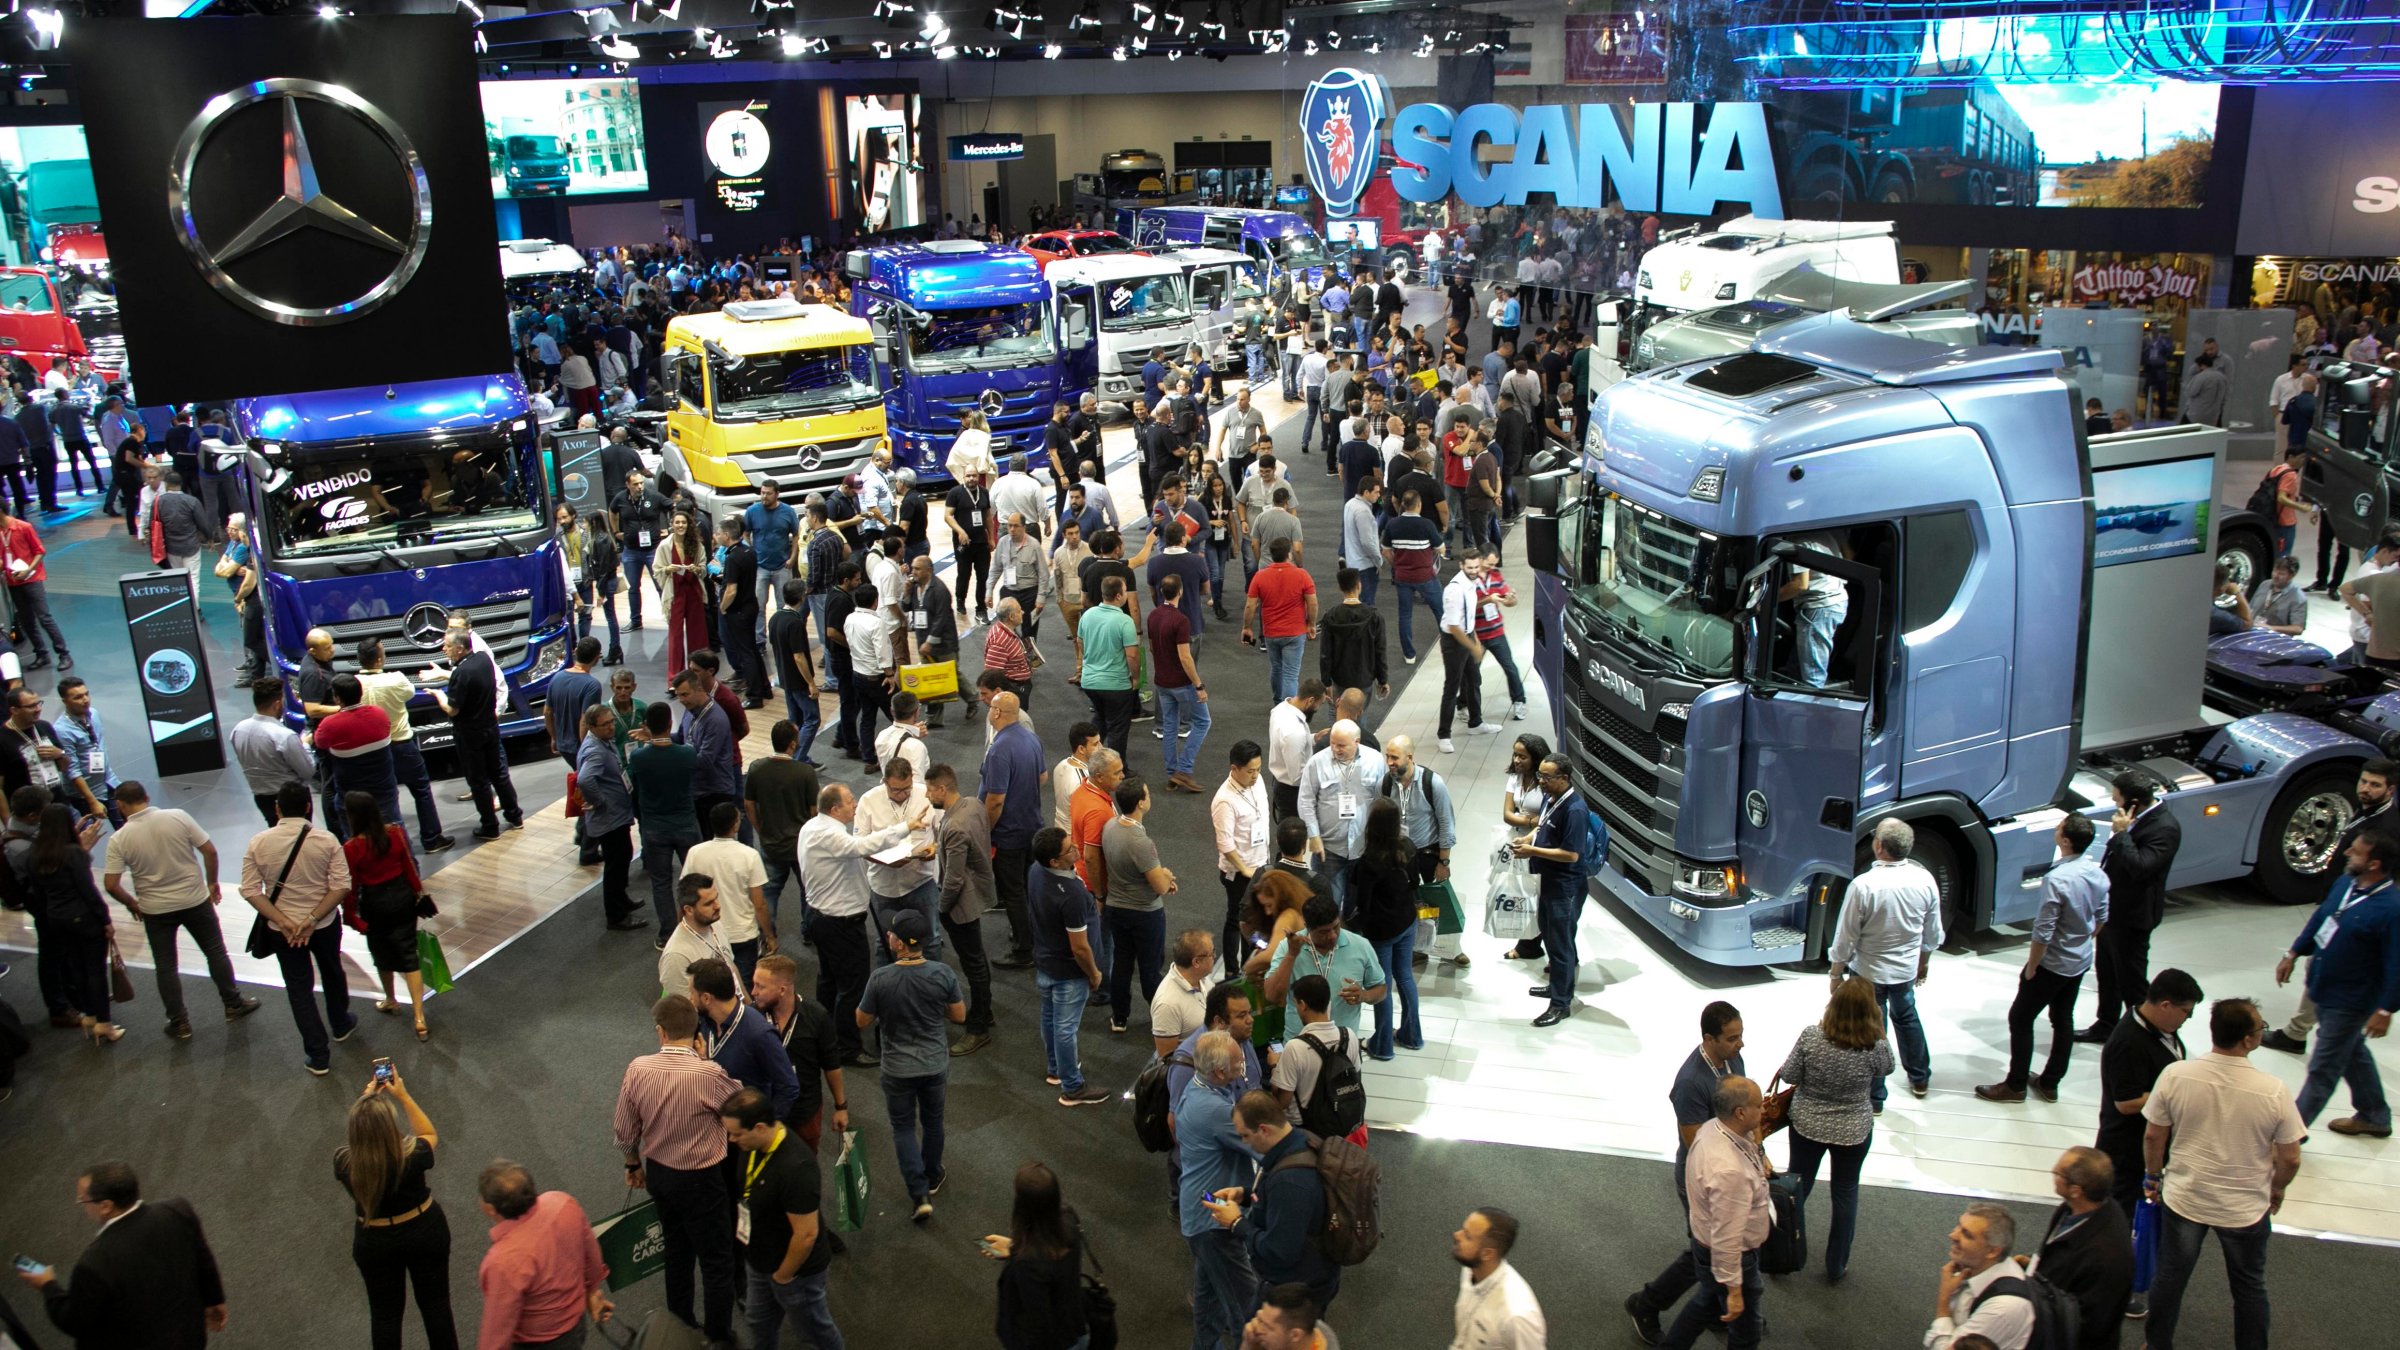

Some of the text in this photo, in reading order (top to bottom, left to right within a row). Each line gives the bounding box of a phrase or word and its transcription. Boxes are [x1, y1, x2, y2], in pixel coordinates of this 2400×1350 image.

[1391, 101, 1786, 220] SCANIA
[2352, 176, 2400, 214] S
[2073, 263, 2198, 299] Tattoo You
[2299, 264, 2400, 282] SCANIA
[561, 440, 588, 452] Axor
[294, 468, 372, 500] VENDIDO
[325, 515, 370, 531] FAGUNDES
[2100, 546, 2138, 557] ECONOMIA
[128, 584, 170, 598] Actros
[1588, 659, 1646, 712] SCANIA
